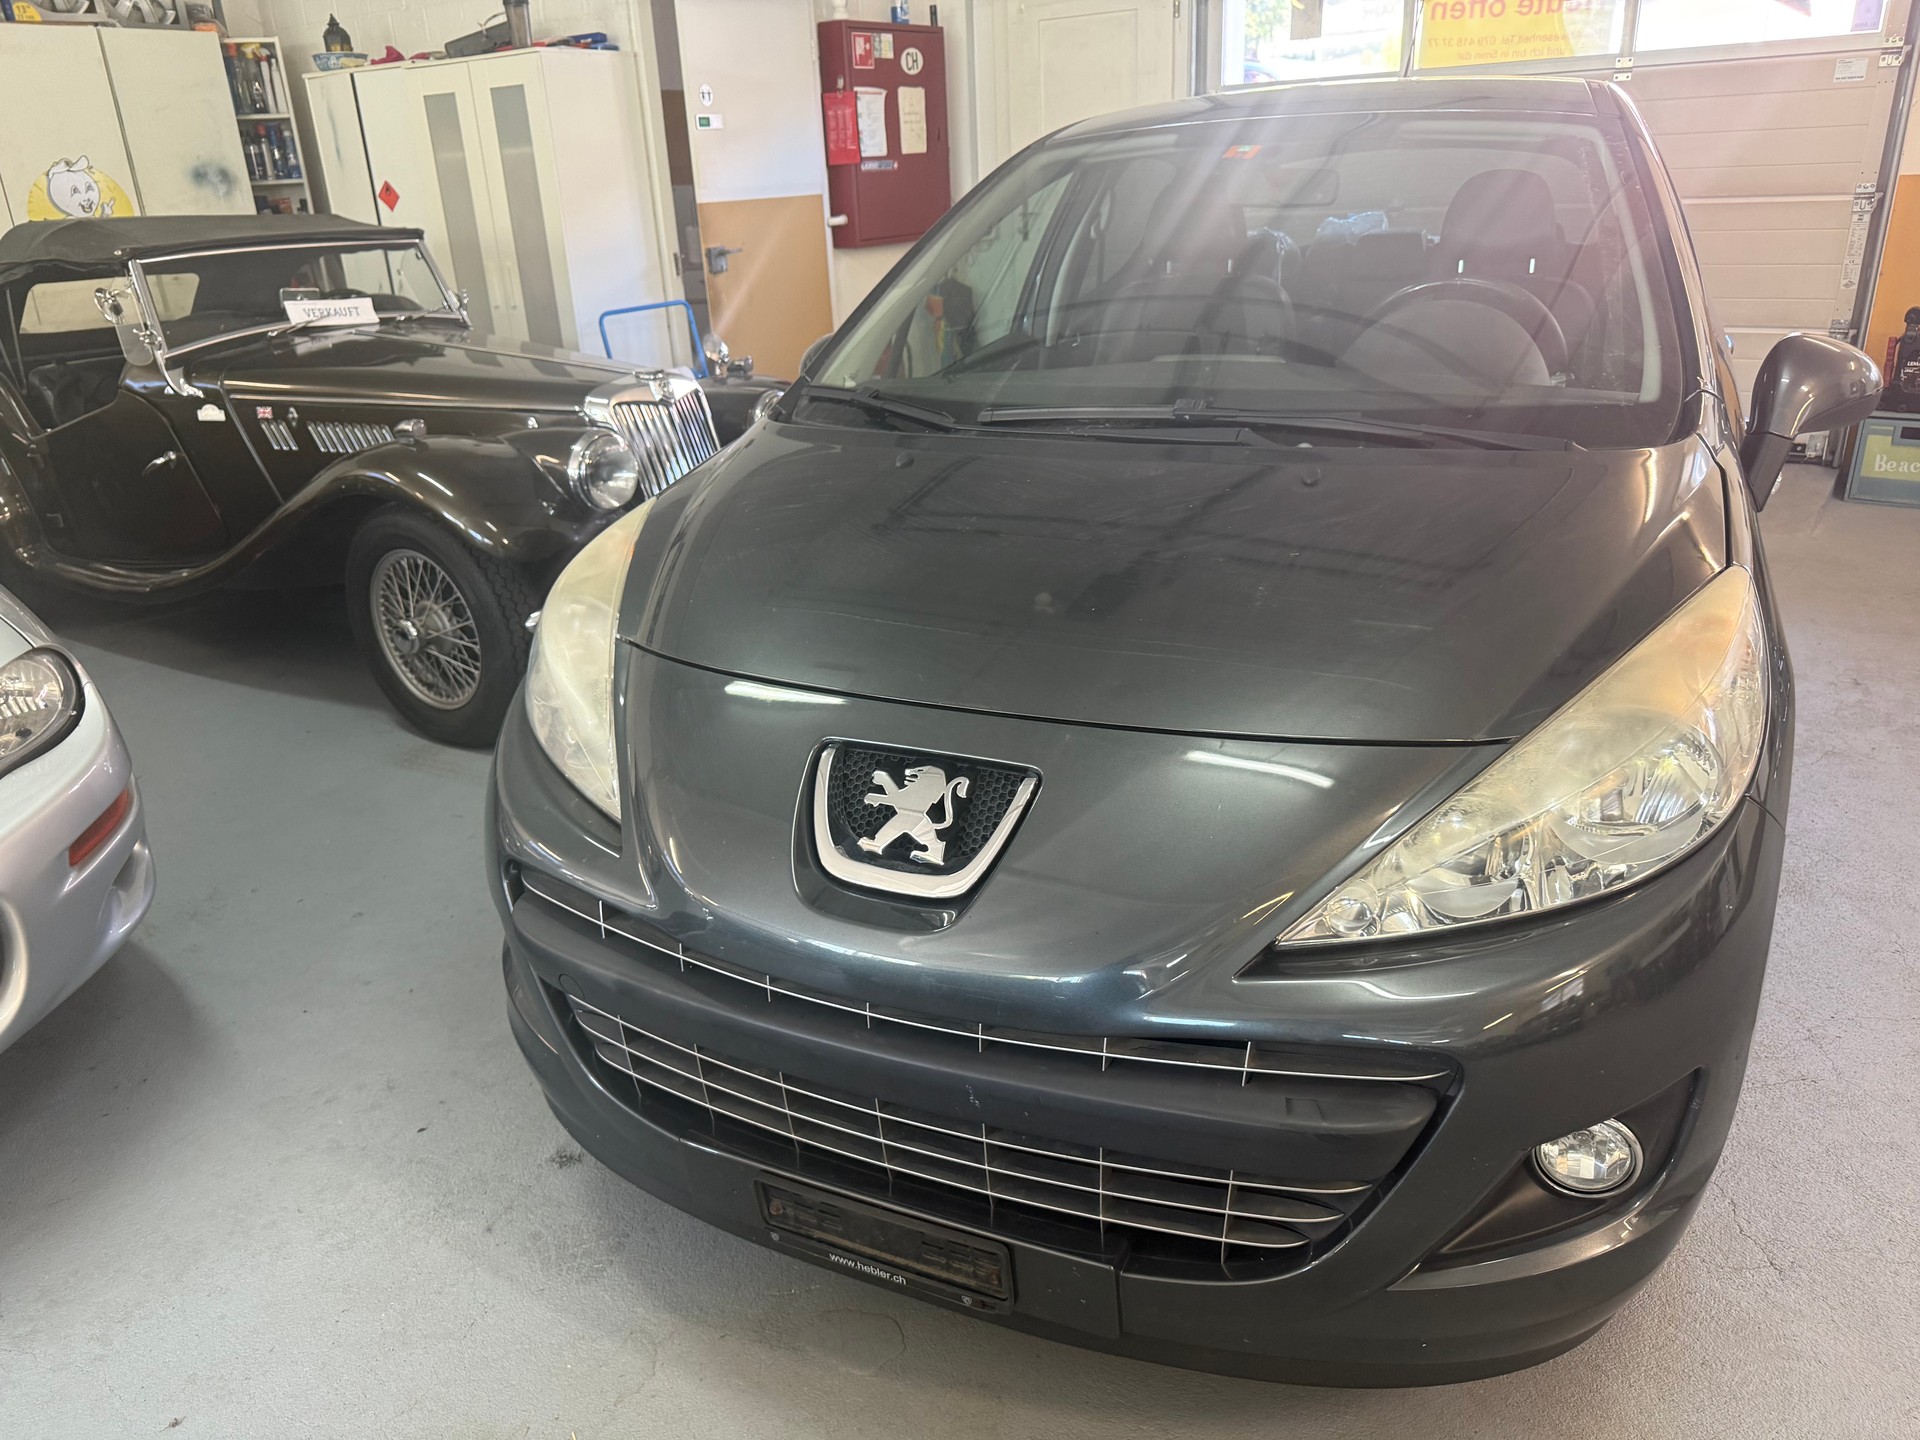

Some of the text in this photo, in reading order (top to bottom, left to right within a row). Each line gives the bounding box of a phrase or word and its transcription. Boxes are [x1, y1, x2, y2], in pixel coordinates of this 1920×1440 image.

[905, 52, 919, 71] CH
[303, 306, 360, 317] VERKAUFT
[1874, 454, 1920, 473] Beac
[829, 1253, 907, 1285] www.hebler.ch
